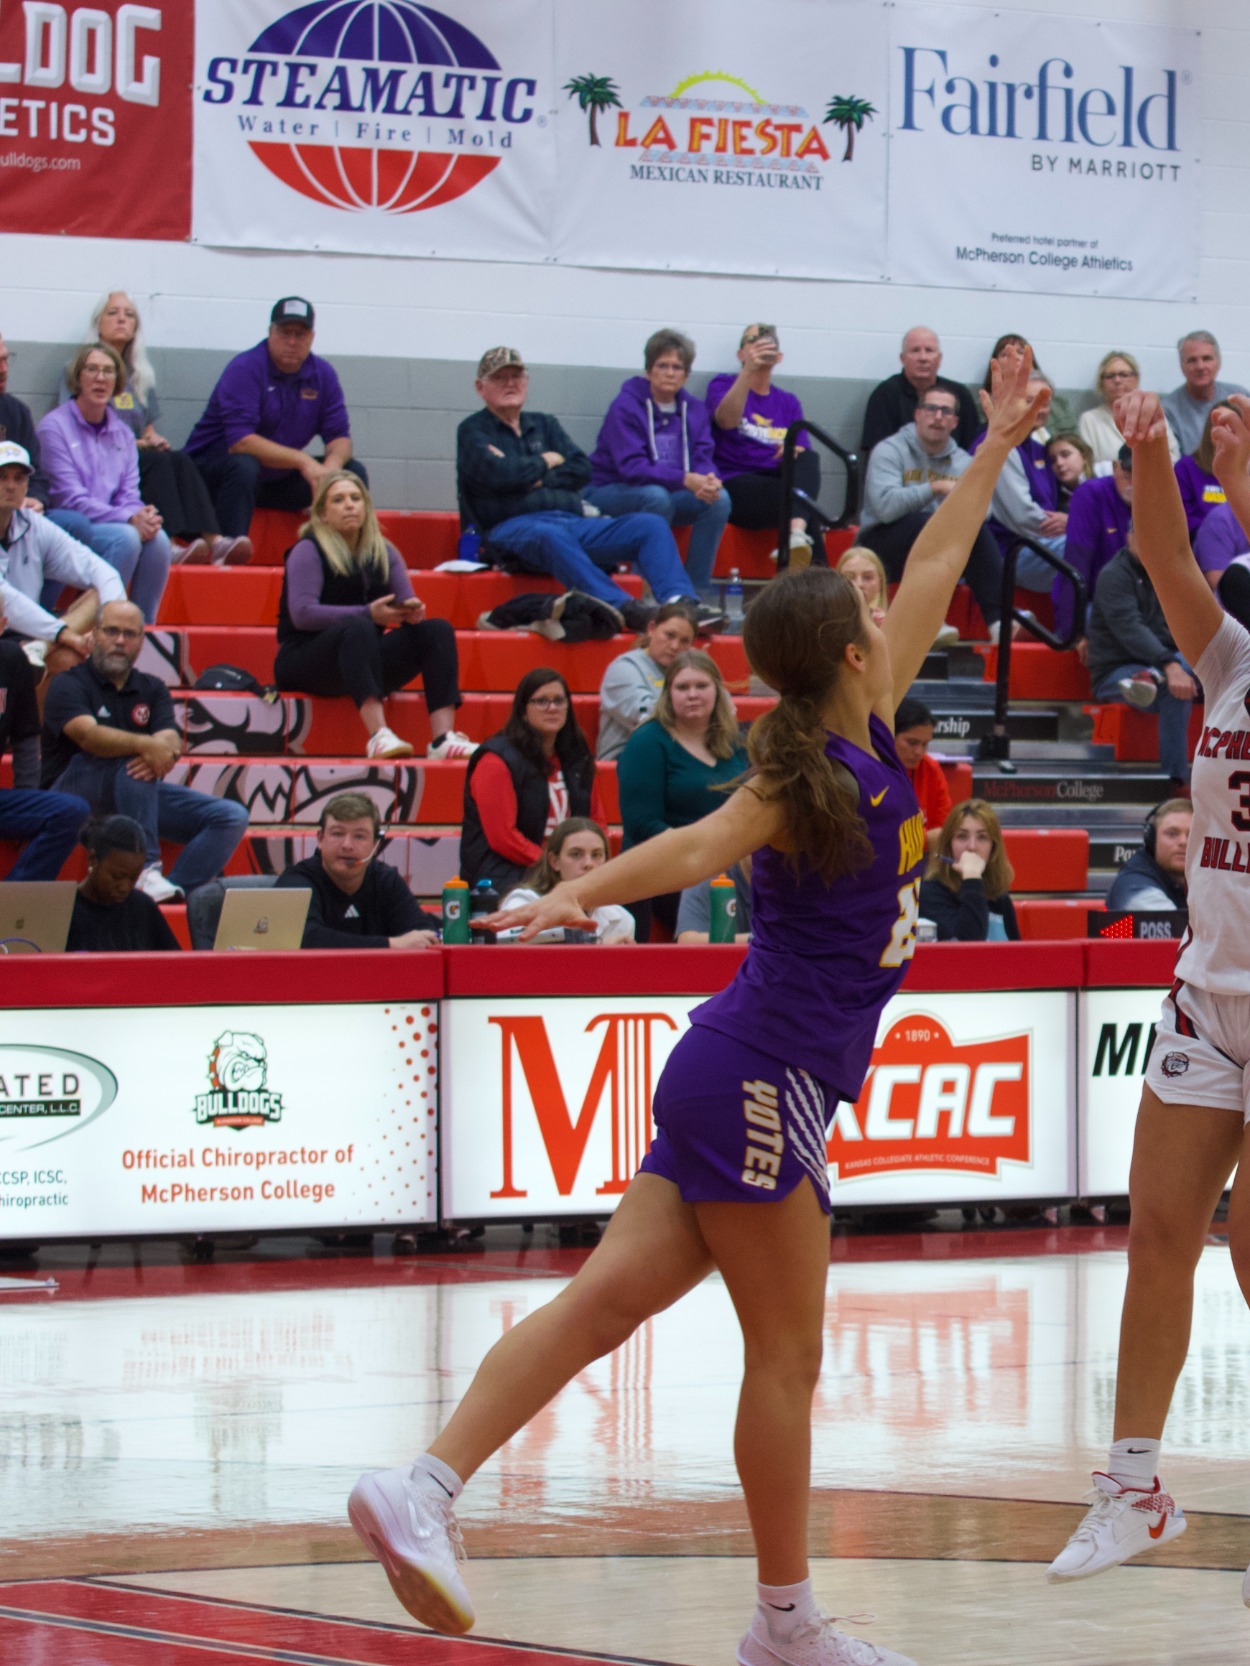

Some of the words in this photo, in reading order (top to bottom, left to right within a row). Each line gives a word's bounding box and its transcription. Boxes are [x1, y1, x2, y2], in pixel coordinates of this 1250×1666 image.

[0, 1, 162, 107] DOG
[203, 57, 537, 124] STEAMATIC
[897, 46, 1182, 152] Fairfield
[0, 98, 116, 146] ETICS
[237, 114, 320, 138] Water
[356, 122, 412, 143] Fire
[448, 128, 513, 149] Mold
[615, 111, 678, 151] LA
[688, 117, 831, 162] FIESTA
[630, 164, 709, 183] MEXICAN
[713, 170, 824, 191] RESTAURANT
[1031, 154, 1059, 172] BY
[1069, 157, 1181, 182] MARRIOTT
[991, 232, 1031, 245] Preferred
[1057, 236, 1089, 250] partner
[956, 246, 1025, 265] McPherson
[1028, 251, 1078, 271] College
[1081, 253, 1133, 272] Athletics
[905, 1029, 931, 1042] 1890
[196, 1091, 281, 1122] BULLDOGS
[741, 1078, 785, 1192] YOTES
[122, 1148, 195, 1170] Official
[201, 1147, 329, 1171] Chiropractor
[334, 1144, 354, 1164] of
[141, 1181, 254, 1204] McPherson
[261, 1180, 336, 1204] College
